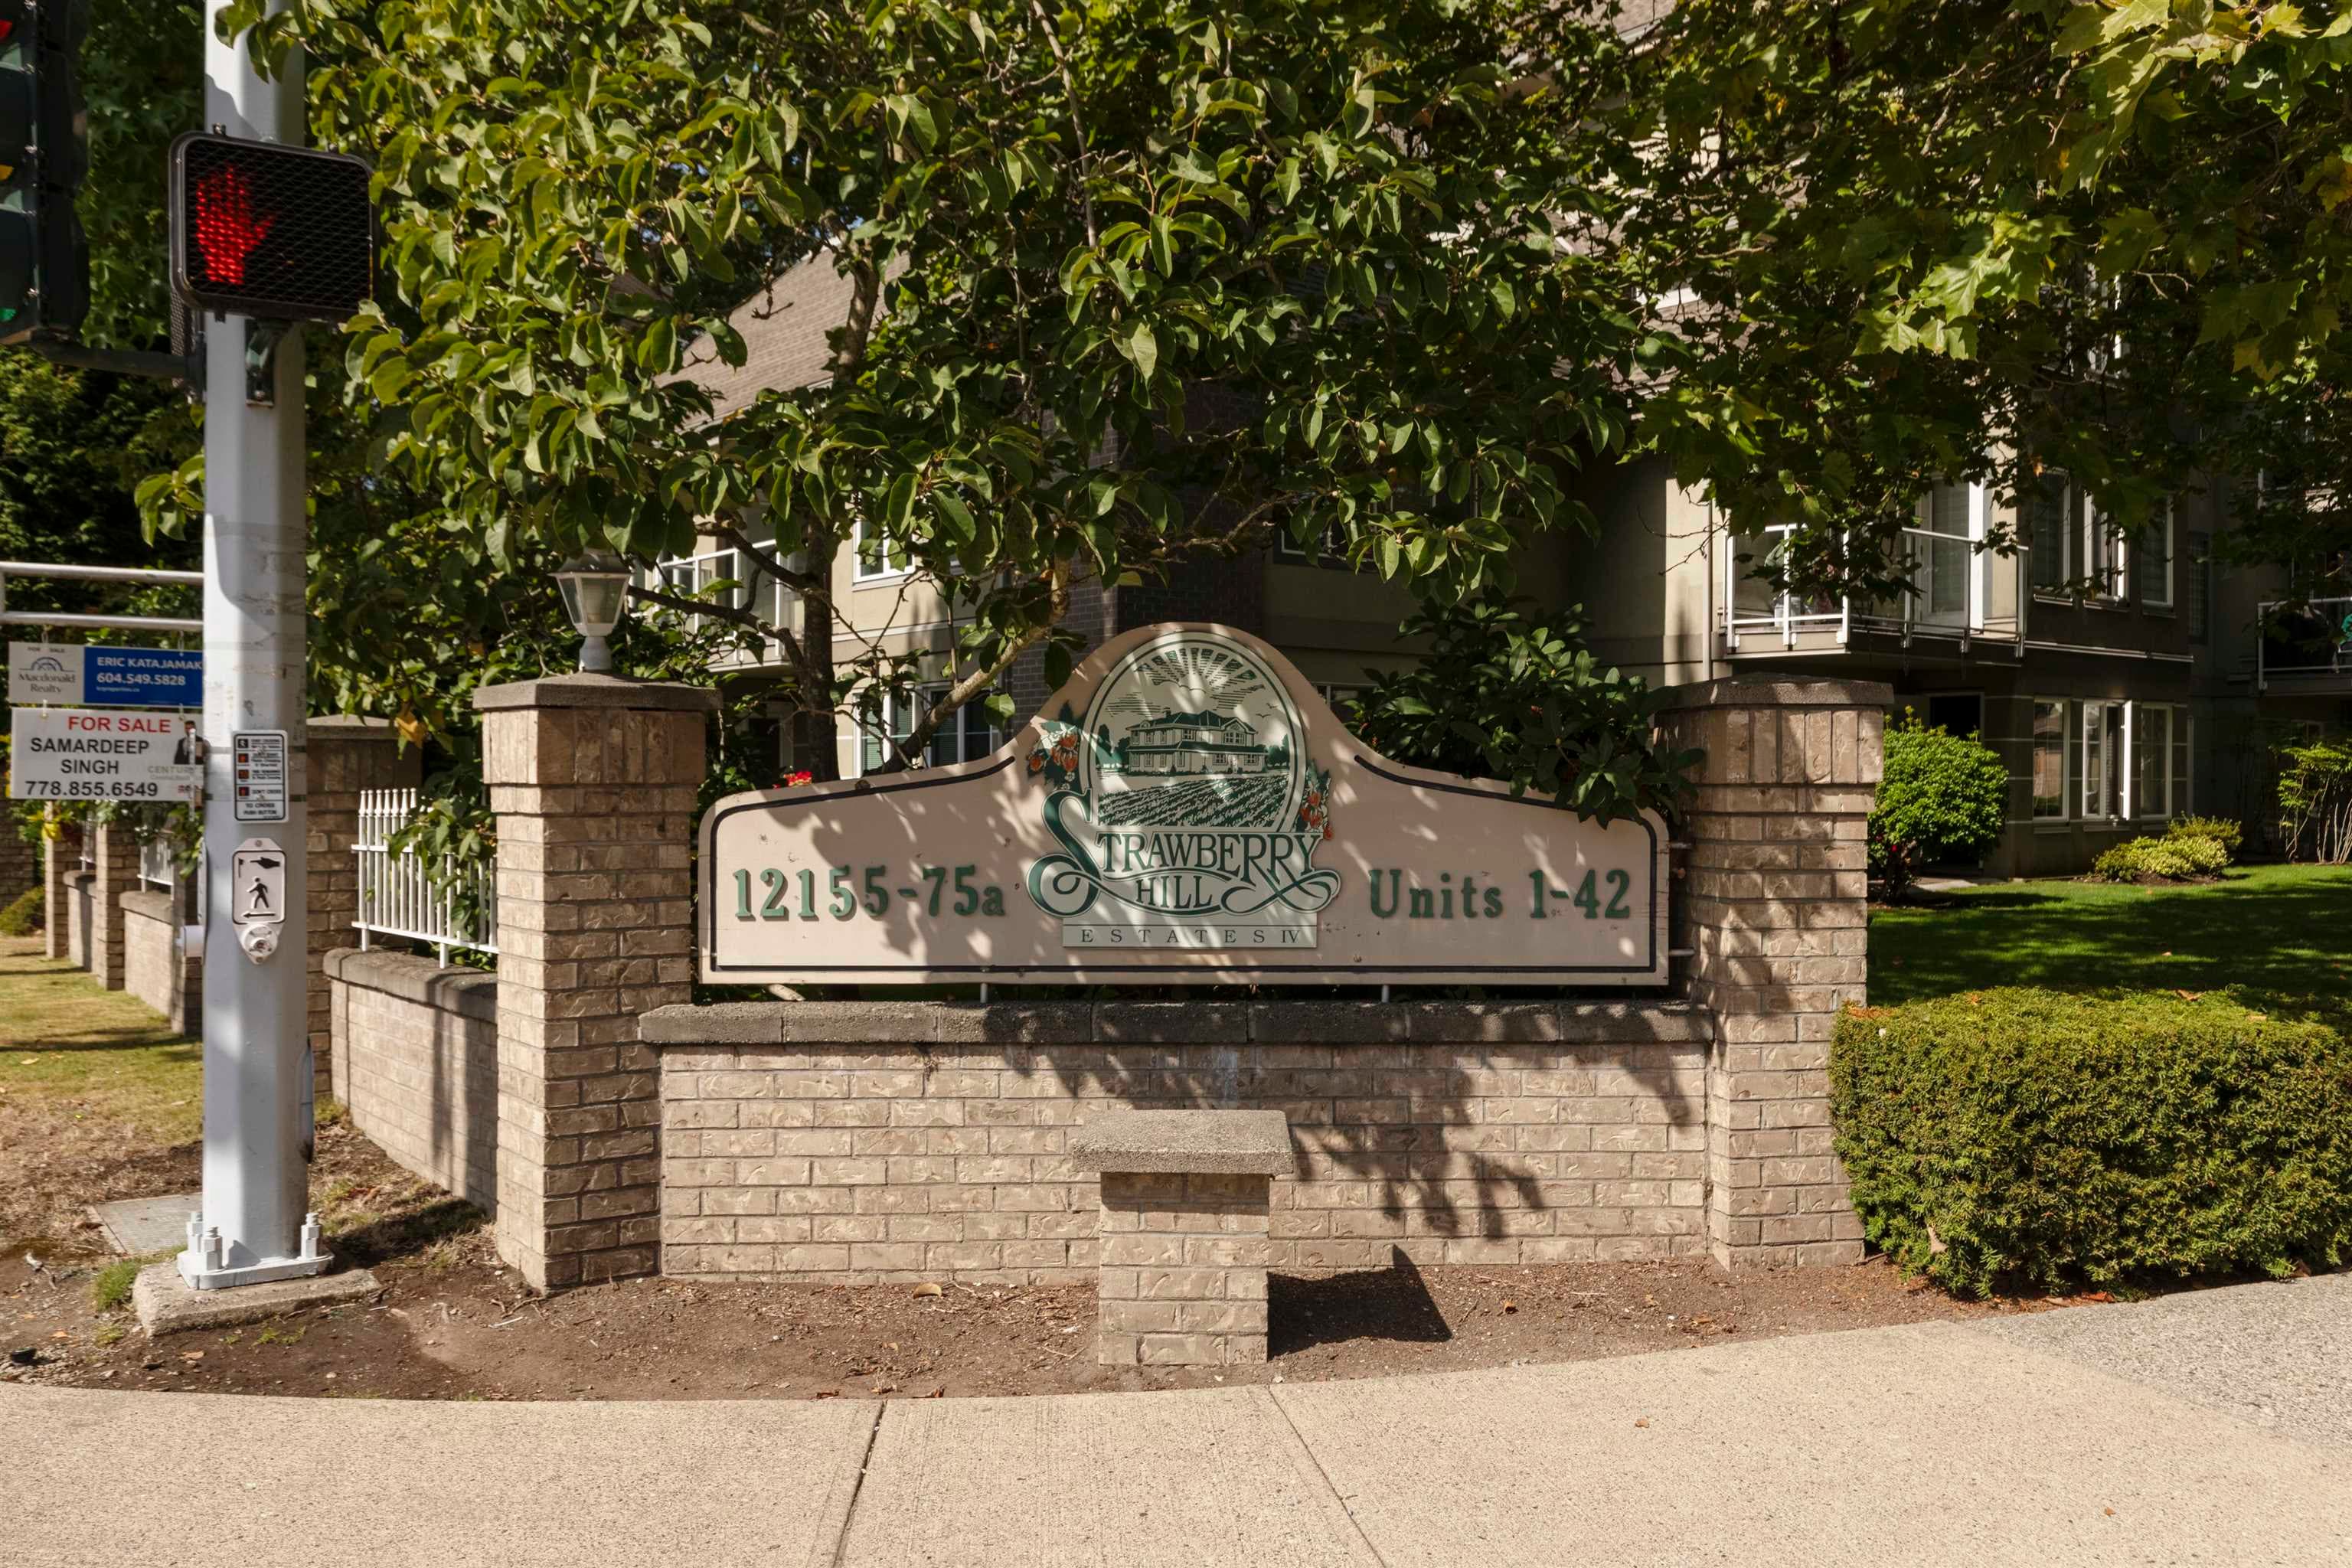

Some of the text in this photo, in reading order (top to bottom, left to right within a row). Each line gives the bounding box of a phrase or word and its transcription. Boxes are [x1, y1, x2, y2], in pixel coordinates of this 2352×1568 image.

[96, 656, 125, 667] ERIC
[18, 673, 75, 683] Macdonald
[96, 672, 186, 686] 604.549.5828
[30, 684, 62, 694] Realty
[68, 717, 171, 733] FOR SALE
[31, 738, 149, 754] SAMARDEEP
[60, 759, 119, 774] SINGH
[25, 781, 158, 797] 778.855.6549
[1027, 789, 1341, 916] STRAWBERRY
[733, 864, 1005, 918] 12155-75a
[1136, 875, 1212, 910] HILL
[1369, 869, 1631, 919] Units 1-42
[1081, 929, 1300, 943] ESTATES IV
